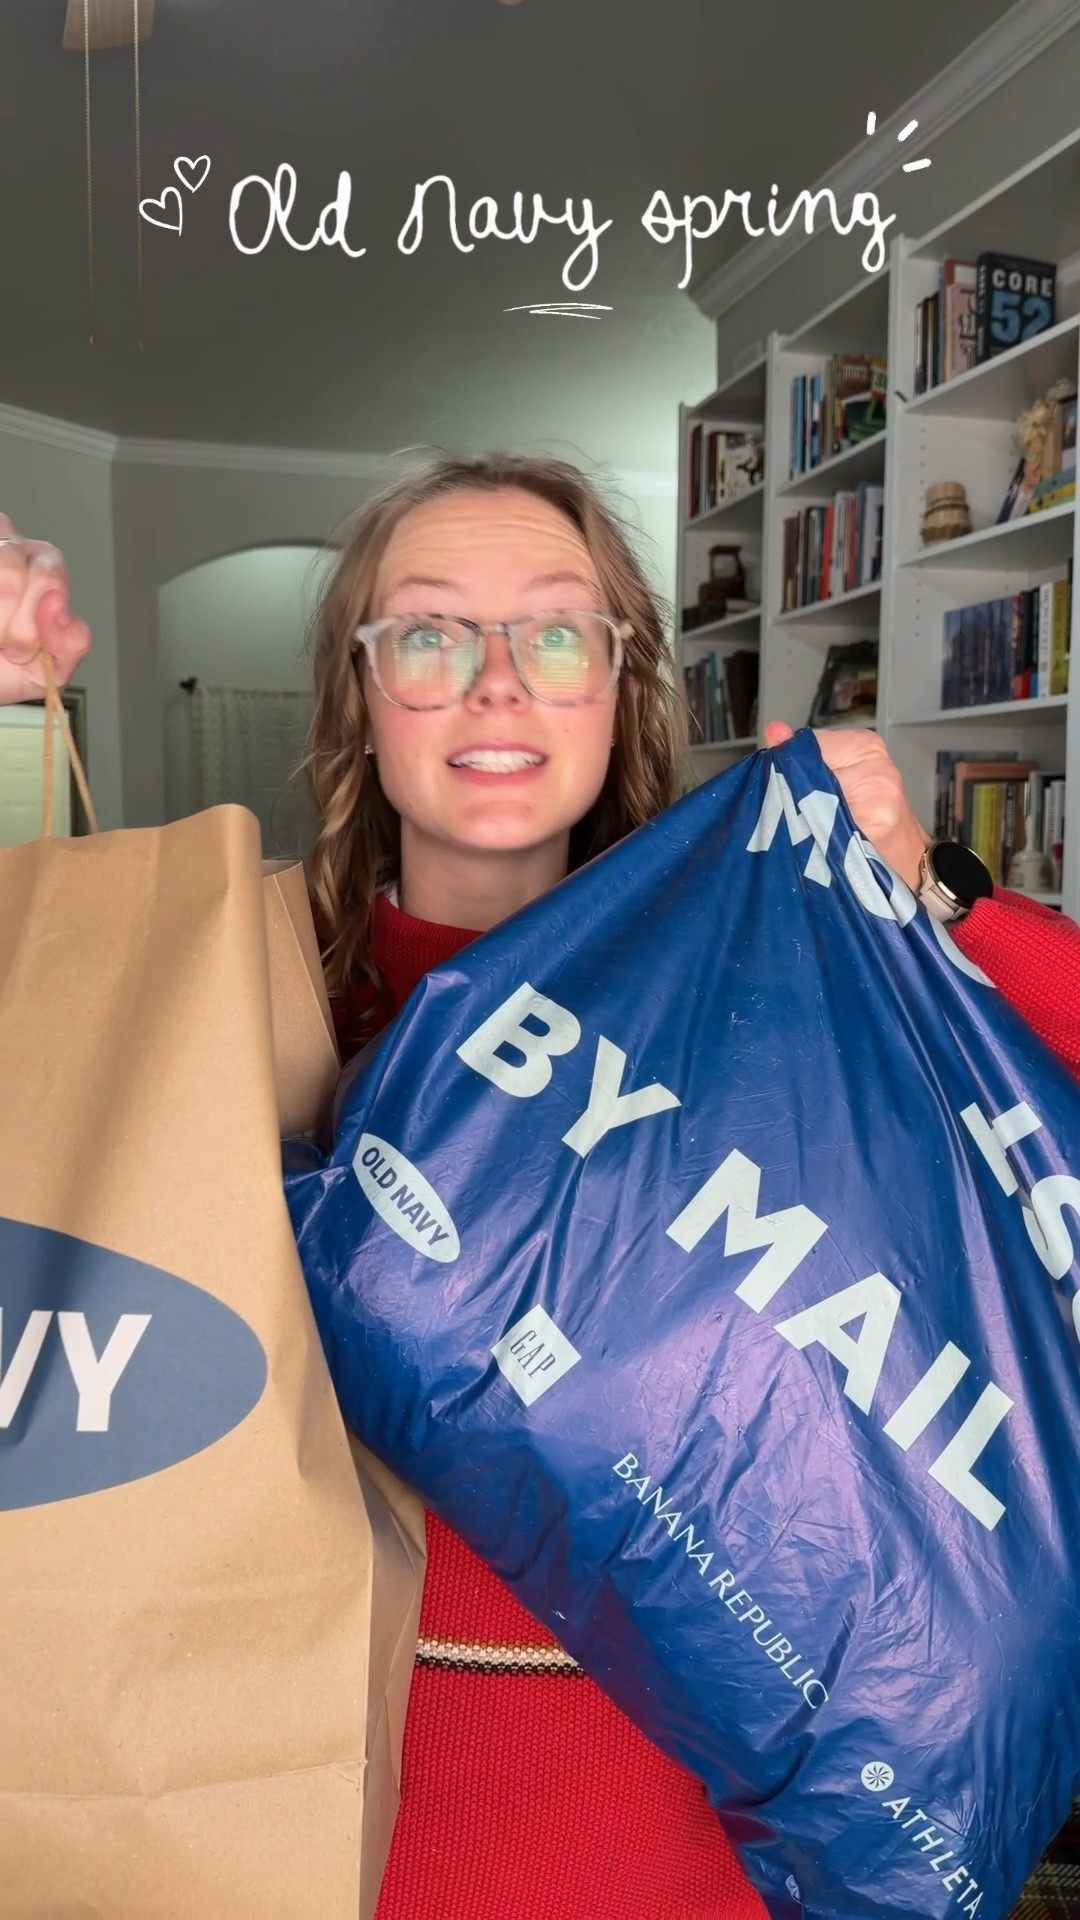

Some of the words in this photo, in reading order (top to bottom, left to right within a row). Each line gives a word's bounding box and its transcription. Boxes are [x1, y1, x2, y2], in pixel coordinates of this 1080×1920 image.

[991, 290, 1052, 344] 52
[992, 269, 1053, 297] CORE
[361, 1147, 397, 1189] OLD
[391, 1186, 449, 1247] NAVY
[456, 982, 682, 1158] BY
[666, 1149, 1014, 1531] MAIL
[510, 1330, 556, 1379] GAP
[612, 1452, 715, 1576] BANANA
[708, 1570, 829, 1709] REPUBLIC
[882, 1797, 983, 1919] ATHLETA
